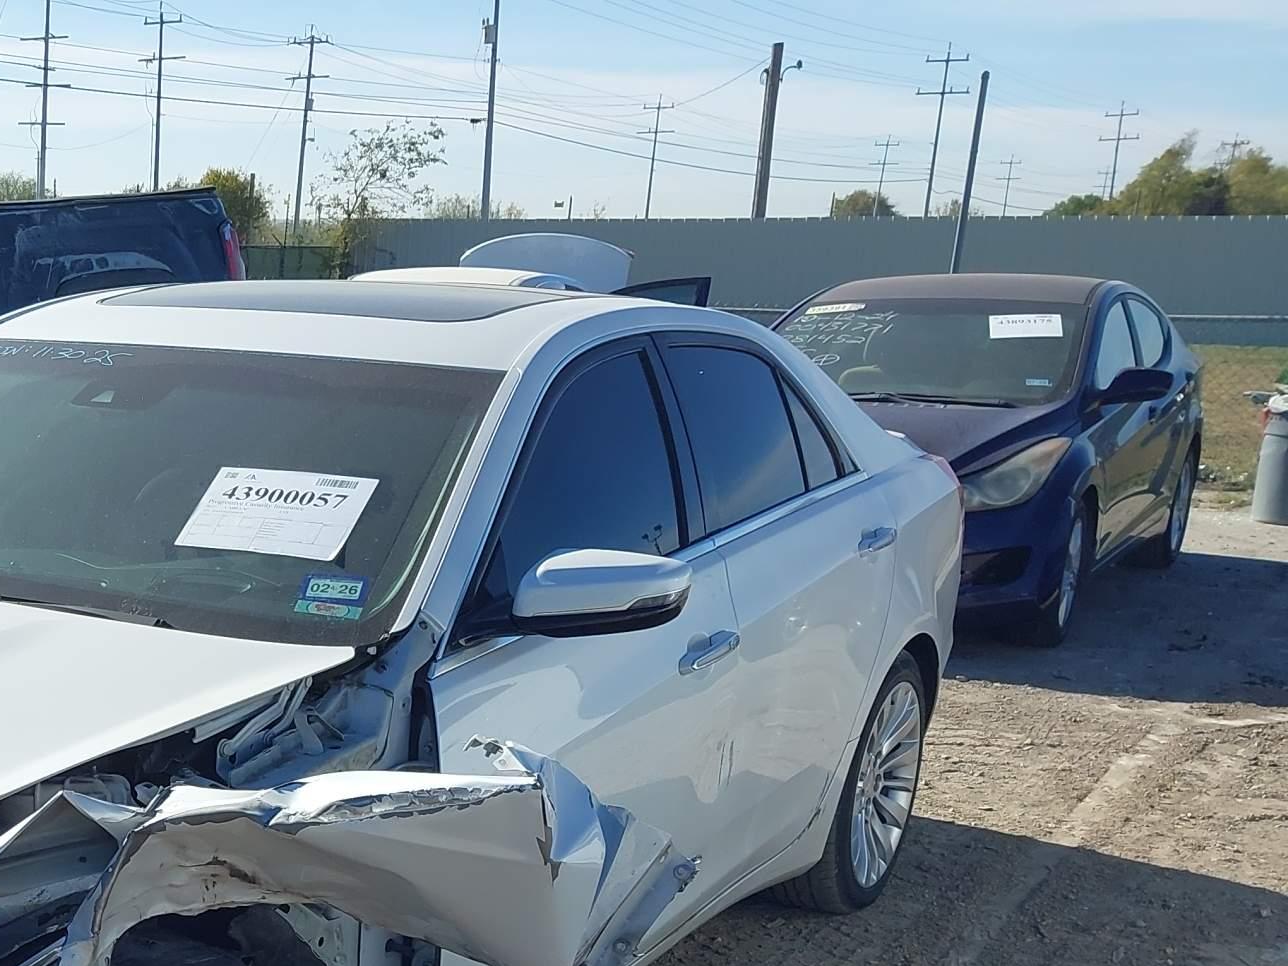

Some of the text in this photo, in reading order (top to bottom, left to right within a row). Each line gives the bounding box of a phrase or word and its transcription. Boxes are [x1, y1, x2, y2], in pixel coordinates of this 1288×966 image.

[222, 485, 349, 510] 43900057
[310, 583, 359, 595] 02 26
